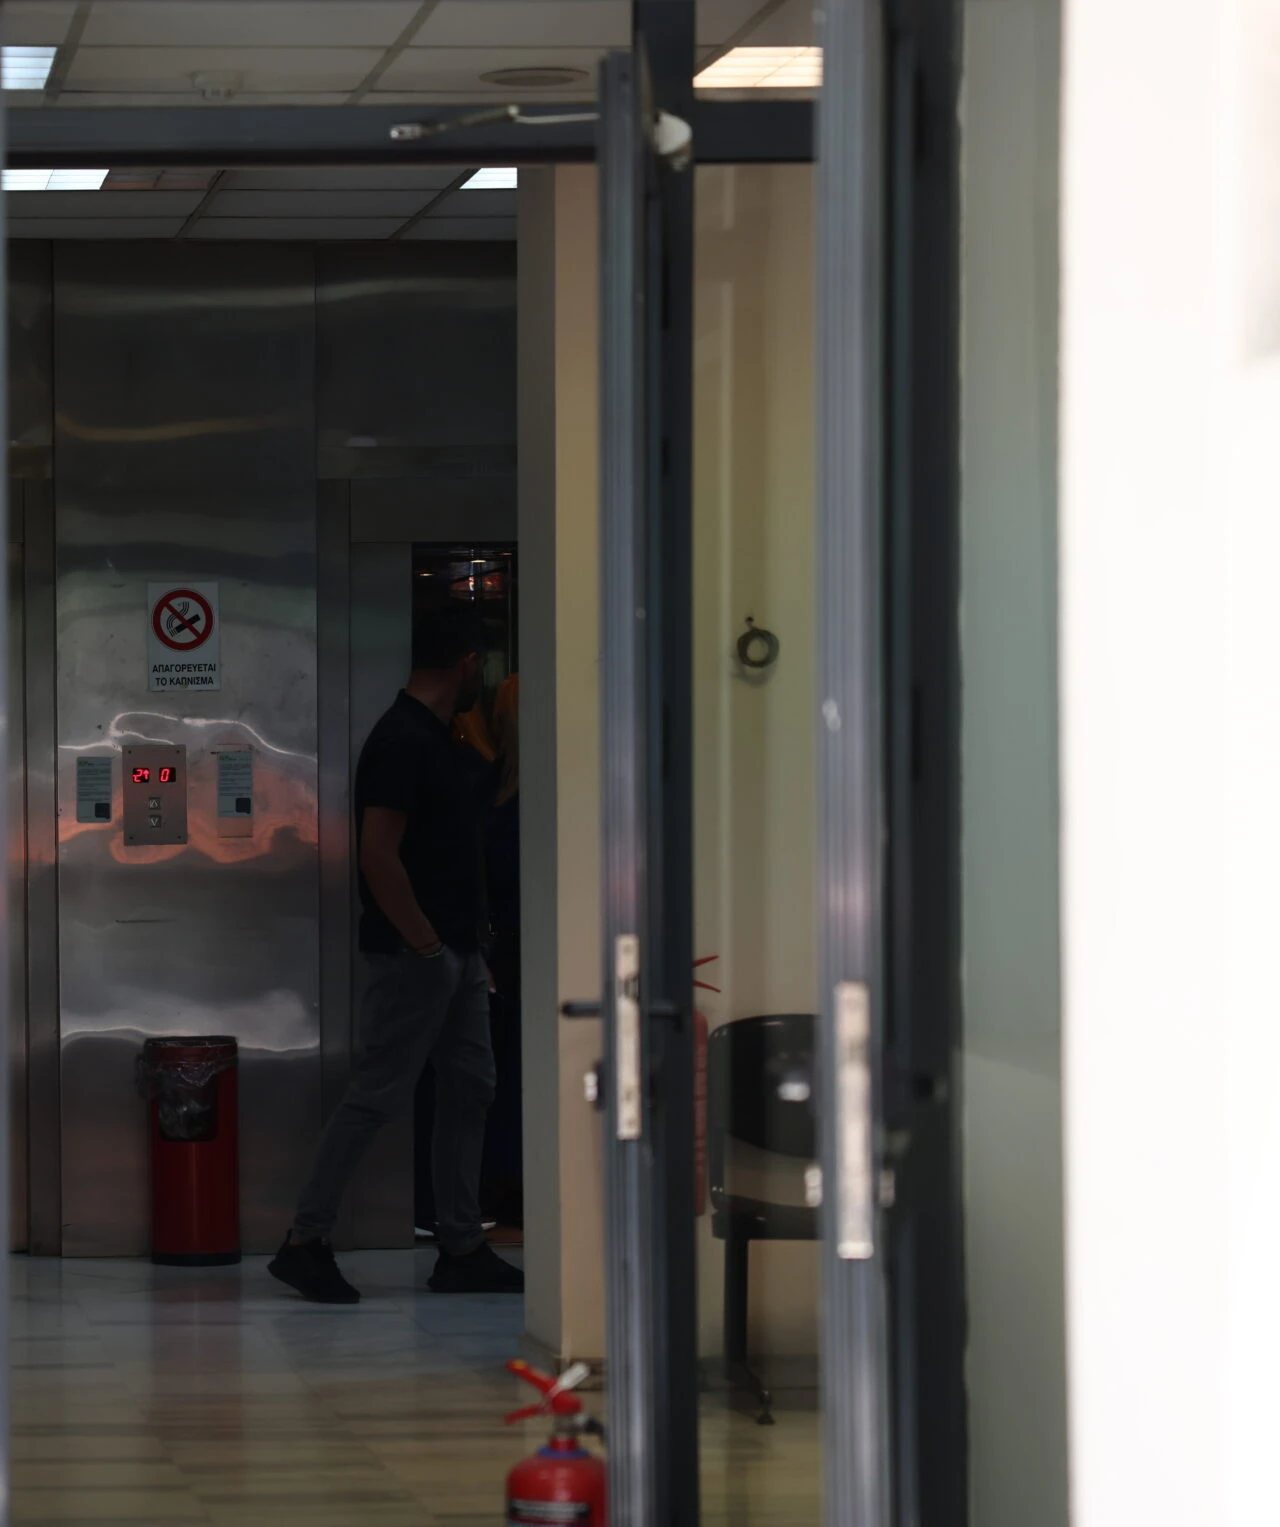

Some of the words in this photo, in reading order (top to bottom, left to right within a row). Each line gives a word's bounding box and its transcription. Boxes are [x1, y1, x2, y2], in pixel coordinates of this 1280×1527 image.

[152, 663, 217, 673] ΑΠΑΓΟΡΕΥΕΤΑΙ
[155, 677, 168, 686] ΤΟ
[169, 676, 214, 686] ΚΑΠΝΙΣΜΑ
